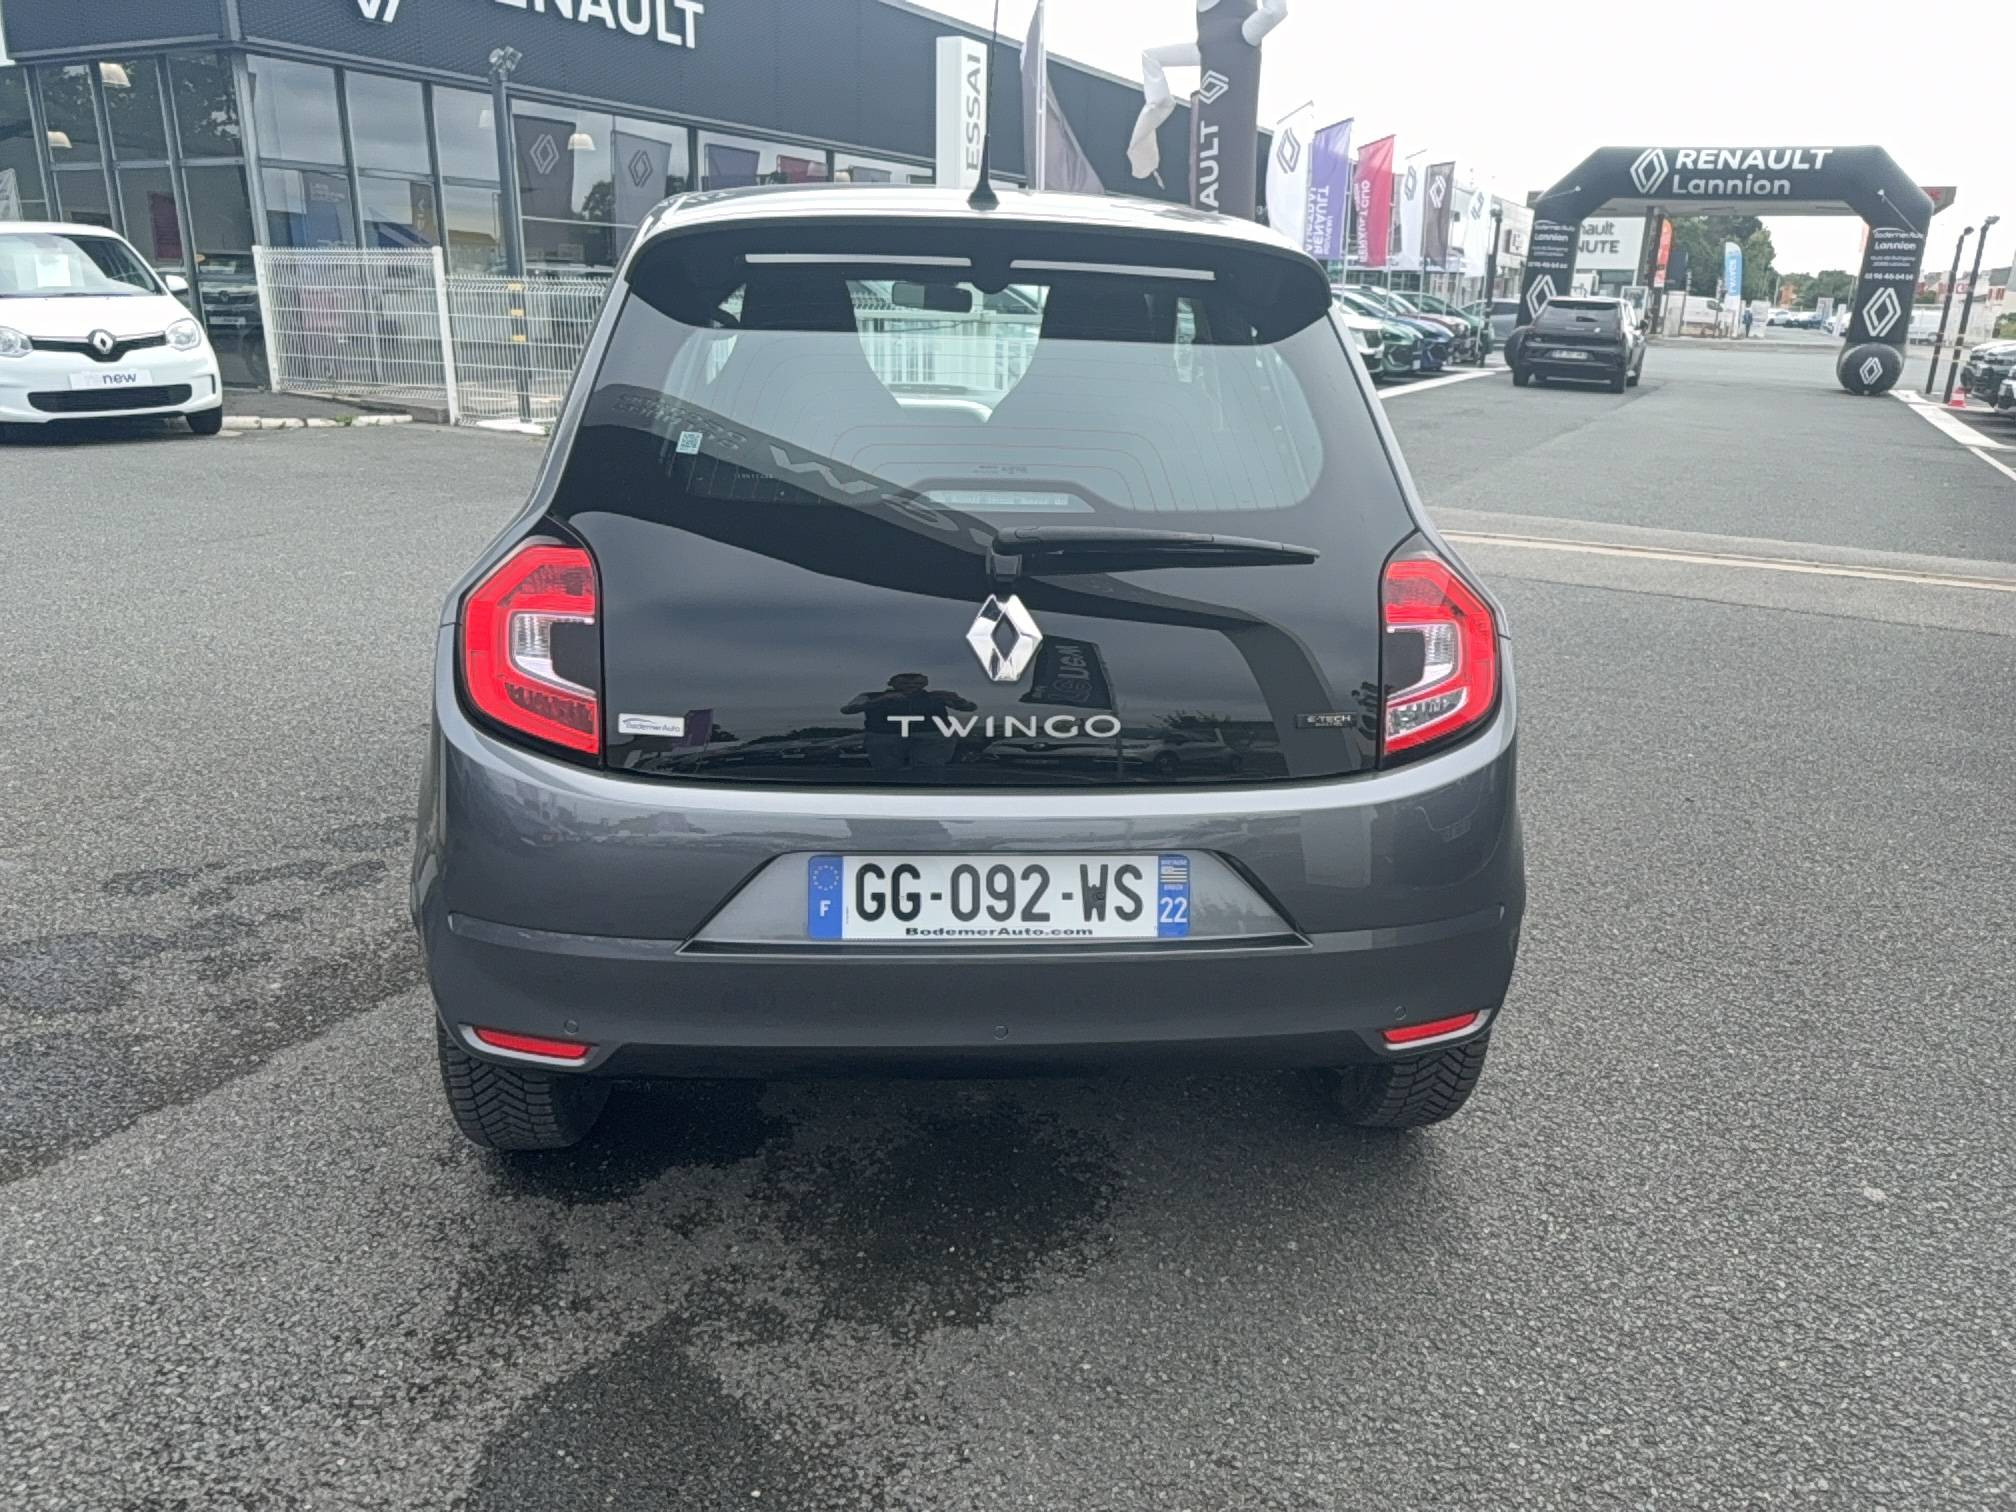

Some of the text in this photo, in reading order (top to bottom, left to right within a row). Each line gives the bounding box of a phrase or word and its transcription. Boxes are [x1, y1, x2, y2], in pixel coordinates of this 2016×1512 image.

[495, 0, 704, 48] AULT
[965, 53, 981, 170] ESSAI
[1199, 120, 1219, 214] AULT
[1674, 149, 1833, 170] RENAULT
[1672, 173, 1791, 195] Lannion
[1873, 240, 1917, 250] Lannion
[886, 714, 1122, 739] TWINGO
[855, 862, 1144, 923] GG-092-WS
[818, 899, 832, 917] F
[1159, 896, 1188, 923] 22
[905, 926, 1094, 937] BodemerAuto.com
